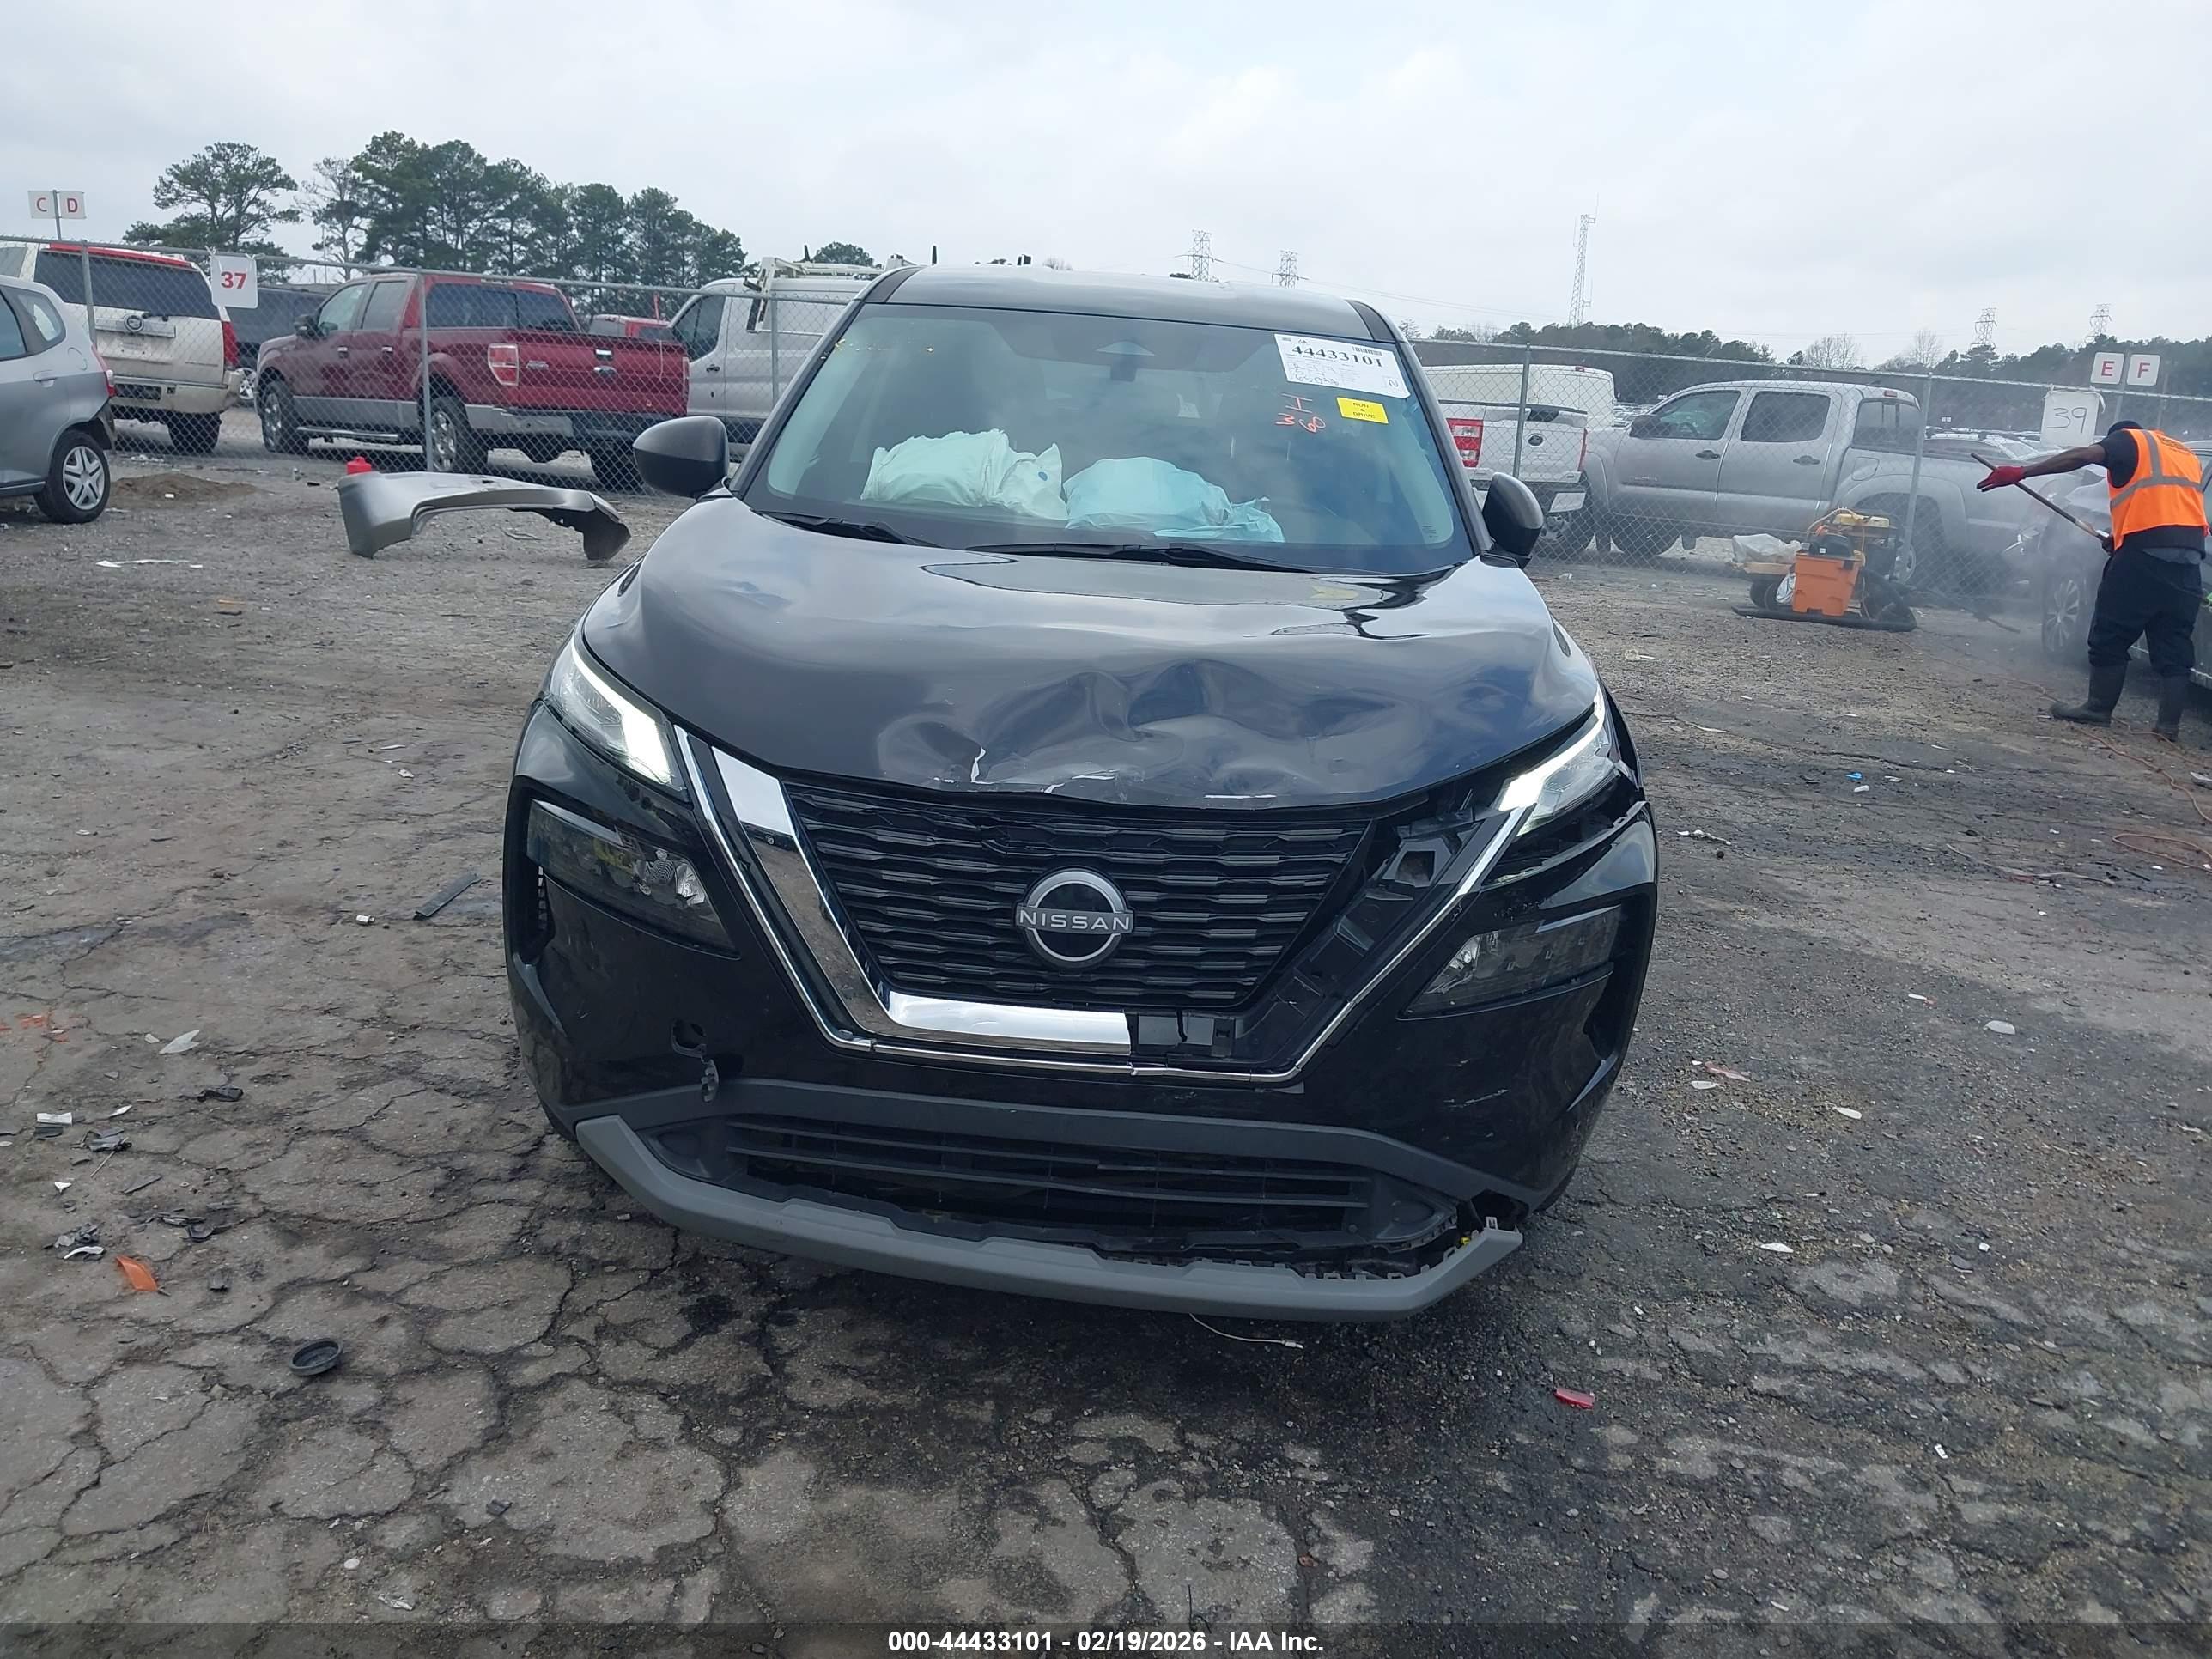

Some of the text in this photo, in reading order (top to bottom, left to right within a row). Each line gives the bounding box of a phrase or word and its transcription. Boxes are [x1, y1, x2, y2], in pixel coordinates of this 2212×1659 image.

[36, 198, 47, 213] C
[66, 198, 78, 213] D
[220, 271, 247, 289] 37
[1291, 345, 1383, 368] 44433101
[2100, 360, 2115, 377] E
[2136, 362, 2151, 379] F
[2046, 406, 2087, 434] 39
[1019, 909, 1130, 931] NISSAN
